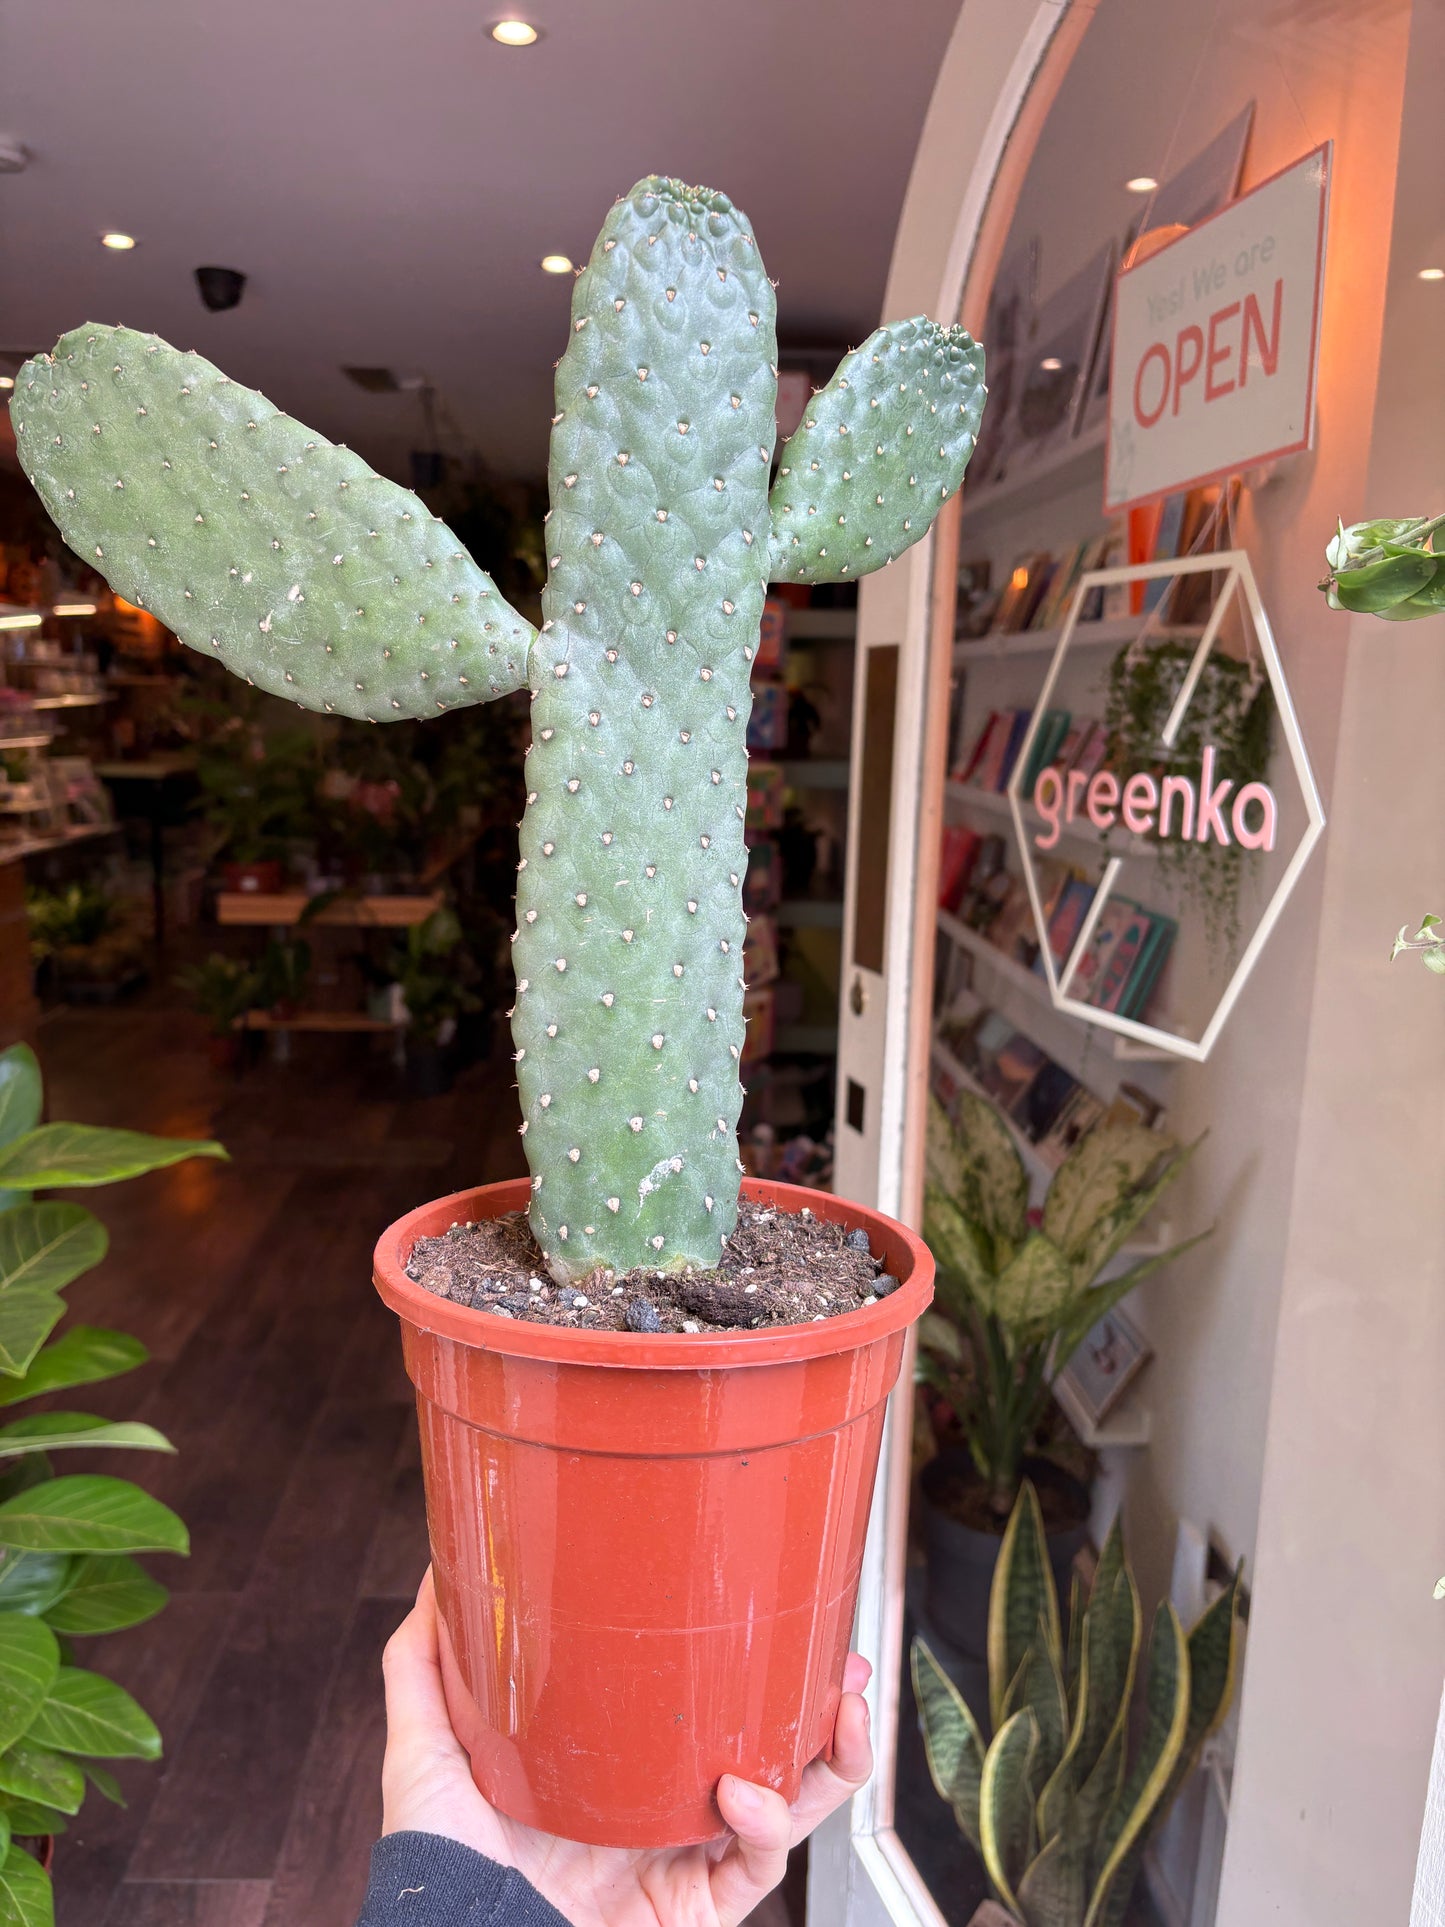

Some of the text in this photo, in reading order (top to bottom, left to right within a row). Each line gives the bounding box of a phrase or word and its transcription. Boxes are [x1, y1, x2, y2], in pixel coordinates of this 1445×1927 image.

[1192, 257, 1227, 302] We
[1234, 234, 1276, 278] are
[1134, 277, 1283, 429] OPEN
[1034, 745, 1276, 851] greenka
